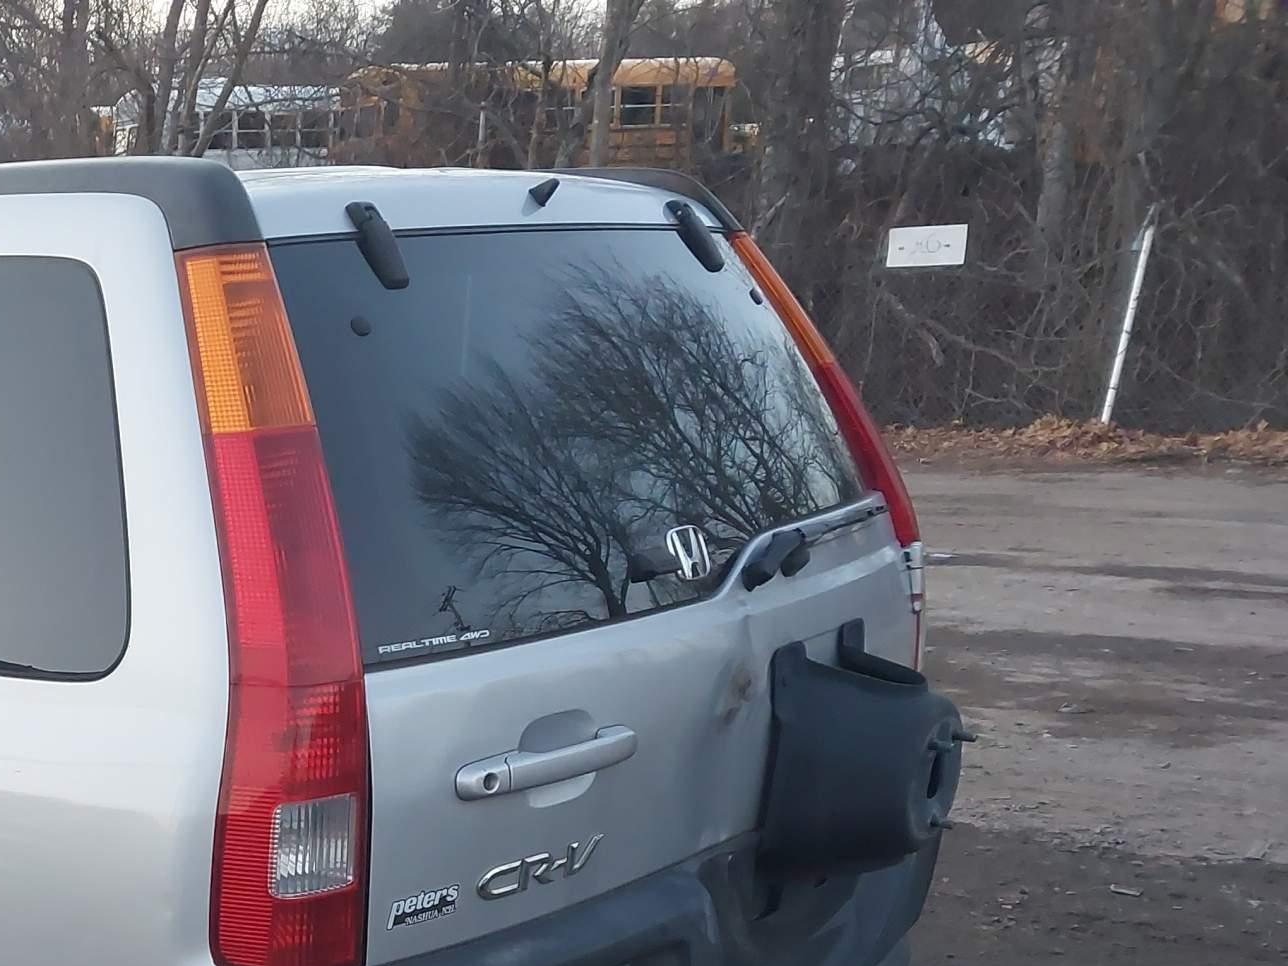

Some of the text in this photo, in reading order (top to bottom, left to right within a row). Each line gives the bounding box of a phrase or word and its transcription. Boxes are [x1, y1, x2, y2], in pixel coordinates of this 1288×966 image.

[378, 634, 457, 654] REALTIME
[476, 833, 604, 900] CR-V
[387, 885, 459, 930] peters
